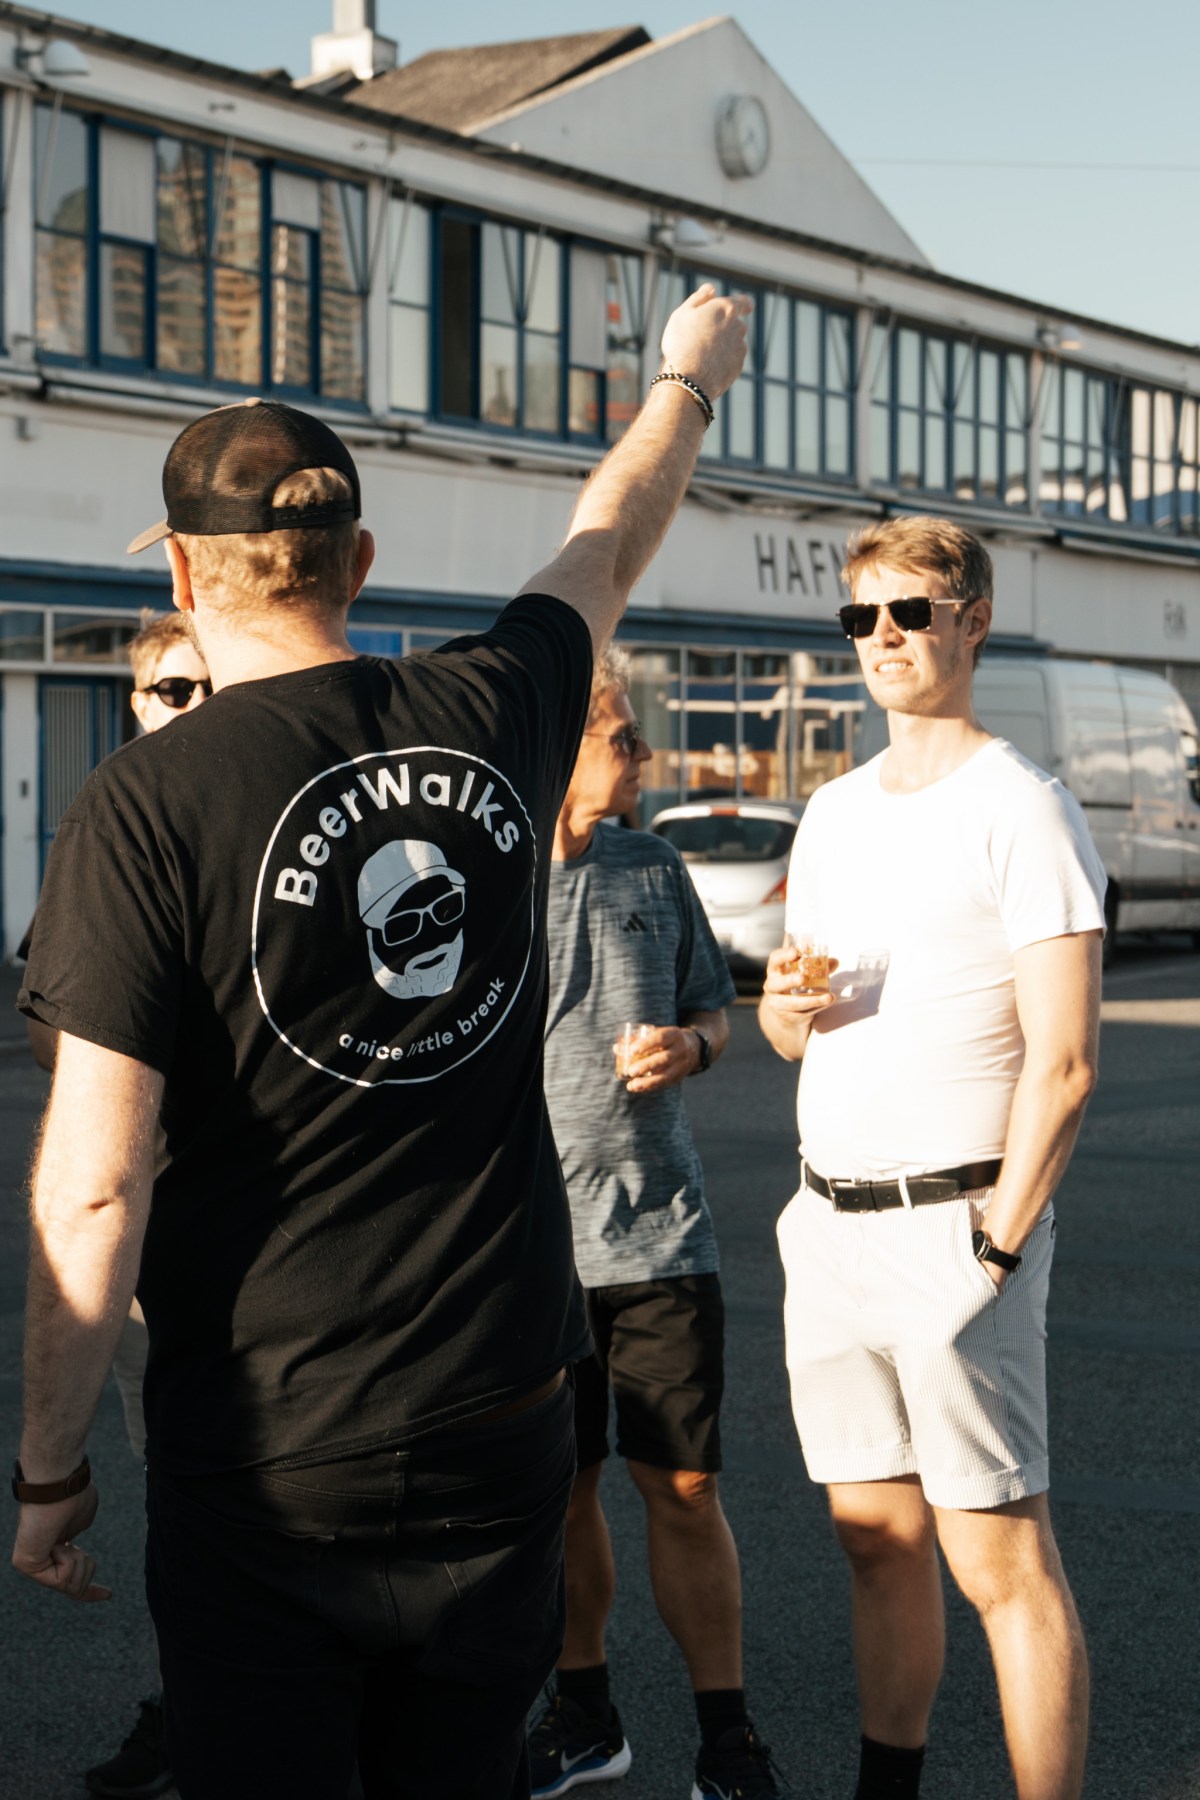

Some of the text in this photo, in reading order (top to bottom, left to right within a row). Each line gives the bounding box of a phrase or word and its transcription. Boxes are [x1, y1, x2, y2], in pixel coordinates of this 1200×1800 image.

[274, 763, 520, 907] BeerWalks
[339, 977, 505, 1061] a nice little break
